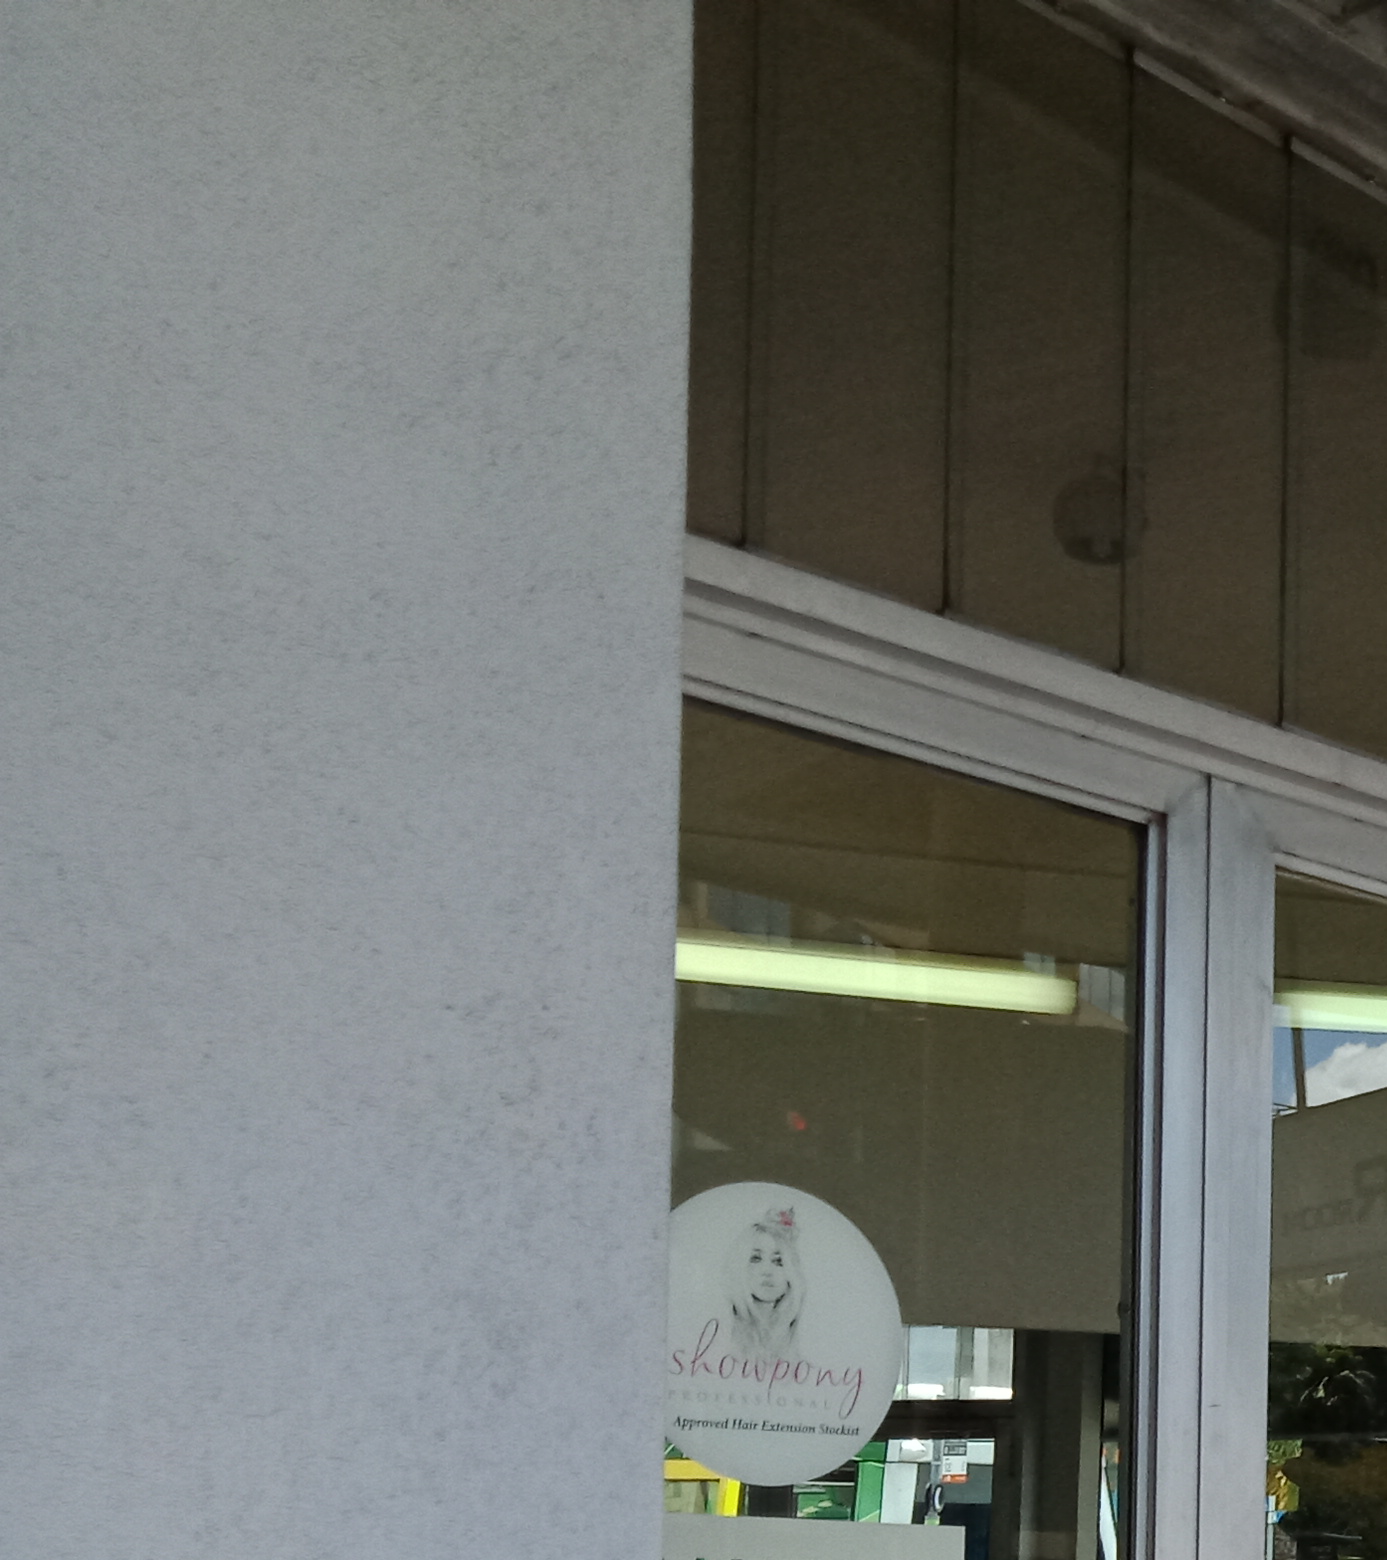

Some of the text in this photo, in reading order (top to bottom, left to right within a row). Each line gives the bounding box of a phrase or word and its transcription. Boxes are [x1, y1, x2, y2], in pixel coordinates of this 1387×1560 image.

[668, 1317, 863, 1419] showpony
[673, 1415, 860, 1437] Approved Hair Extension Stockist
